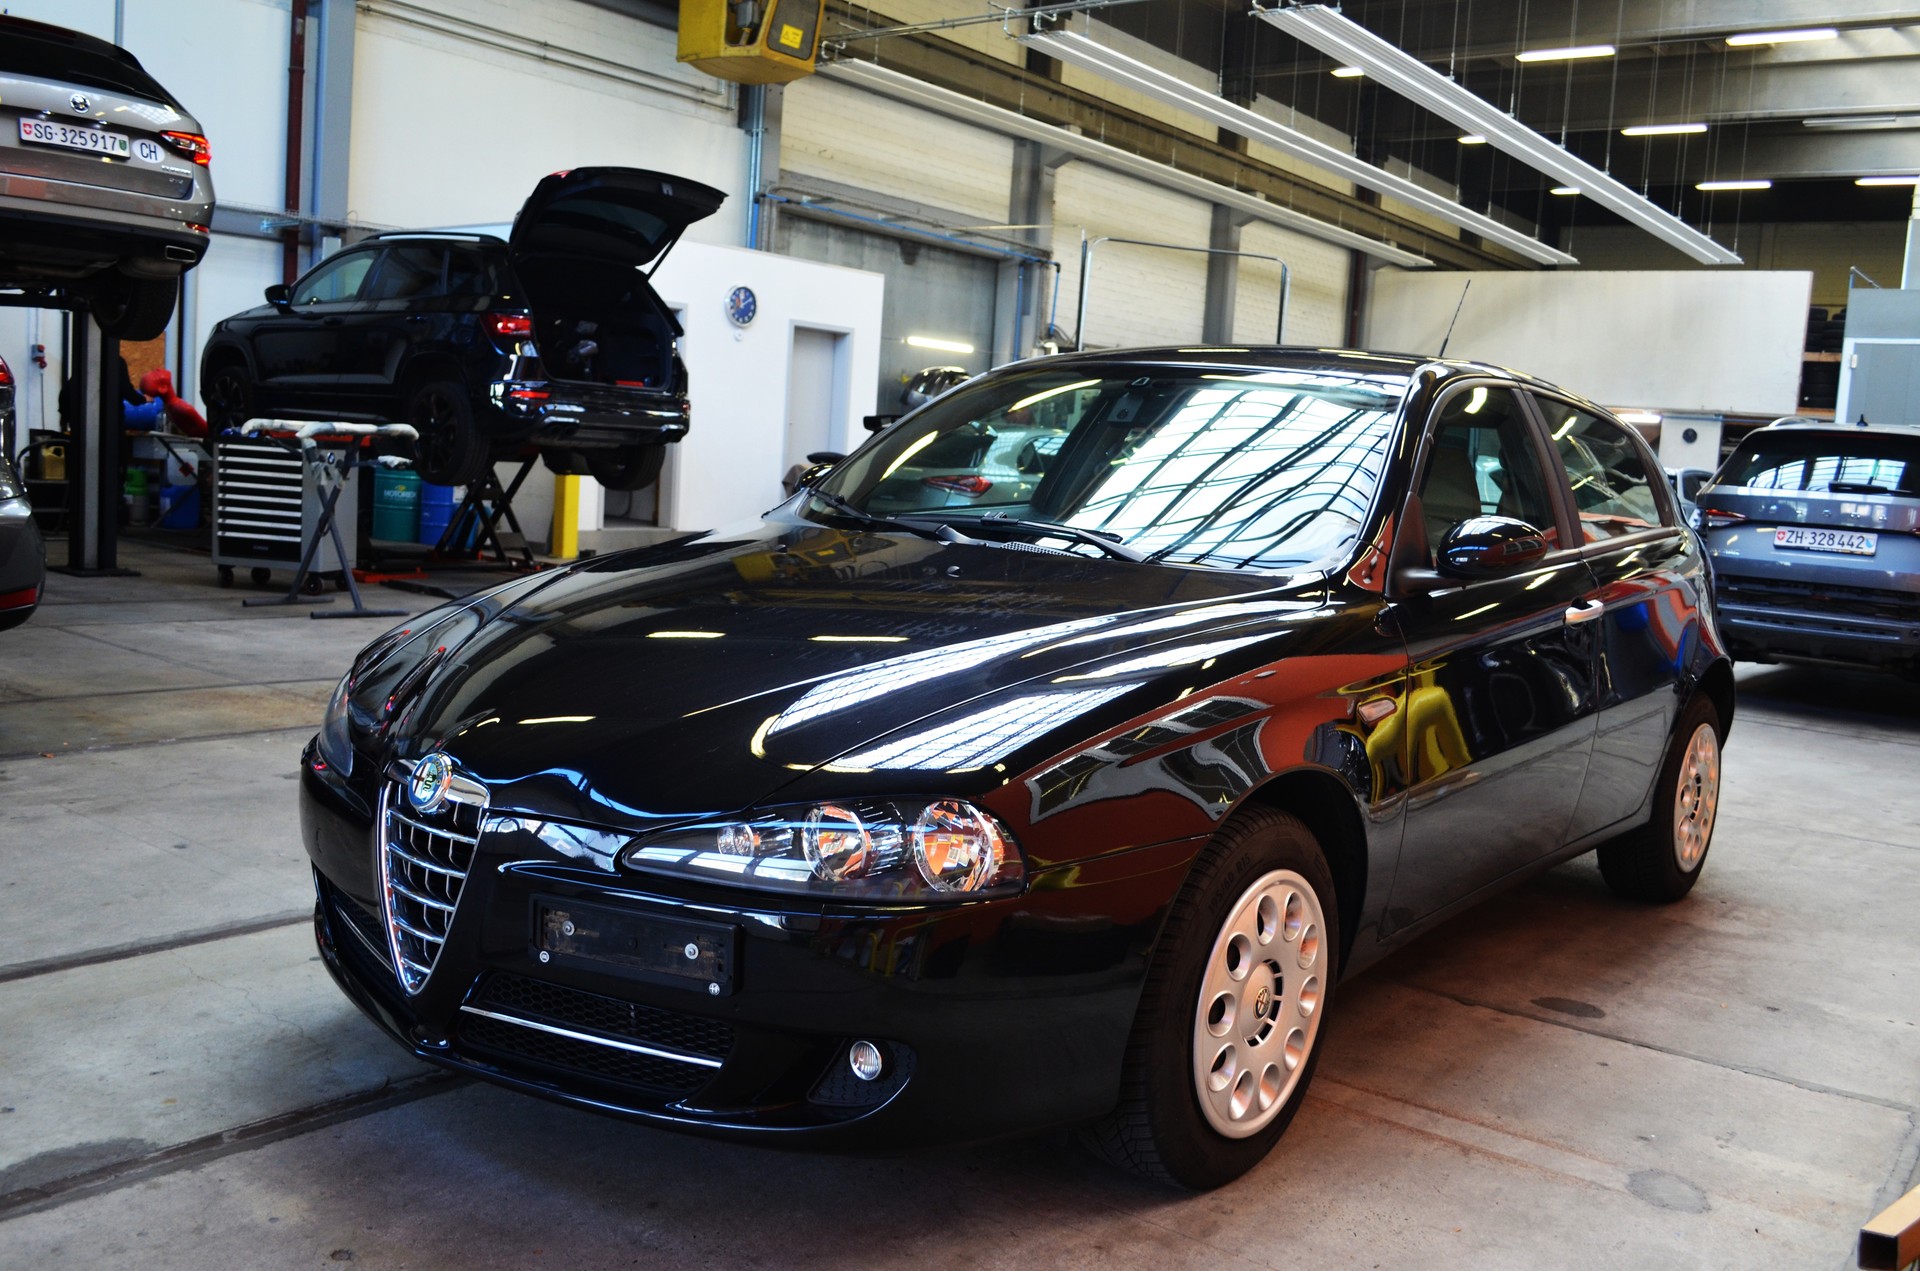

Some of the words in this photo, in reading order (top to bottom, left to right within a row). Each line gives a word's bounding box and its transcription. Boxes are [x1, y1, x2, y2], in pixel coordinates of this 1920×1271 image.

[140, 143, 158, 161] CH
[1208, 872, 1234, 914] 195/60
[1236, 853, 1250, 874] R15
